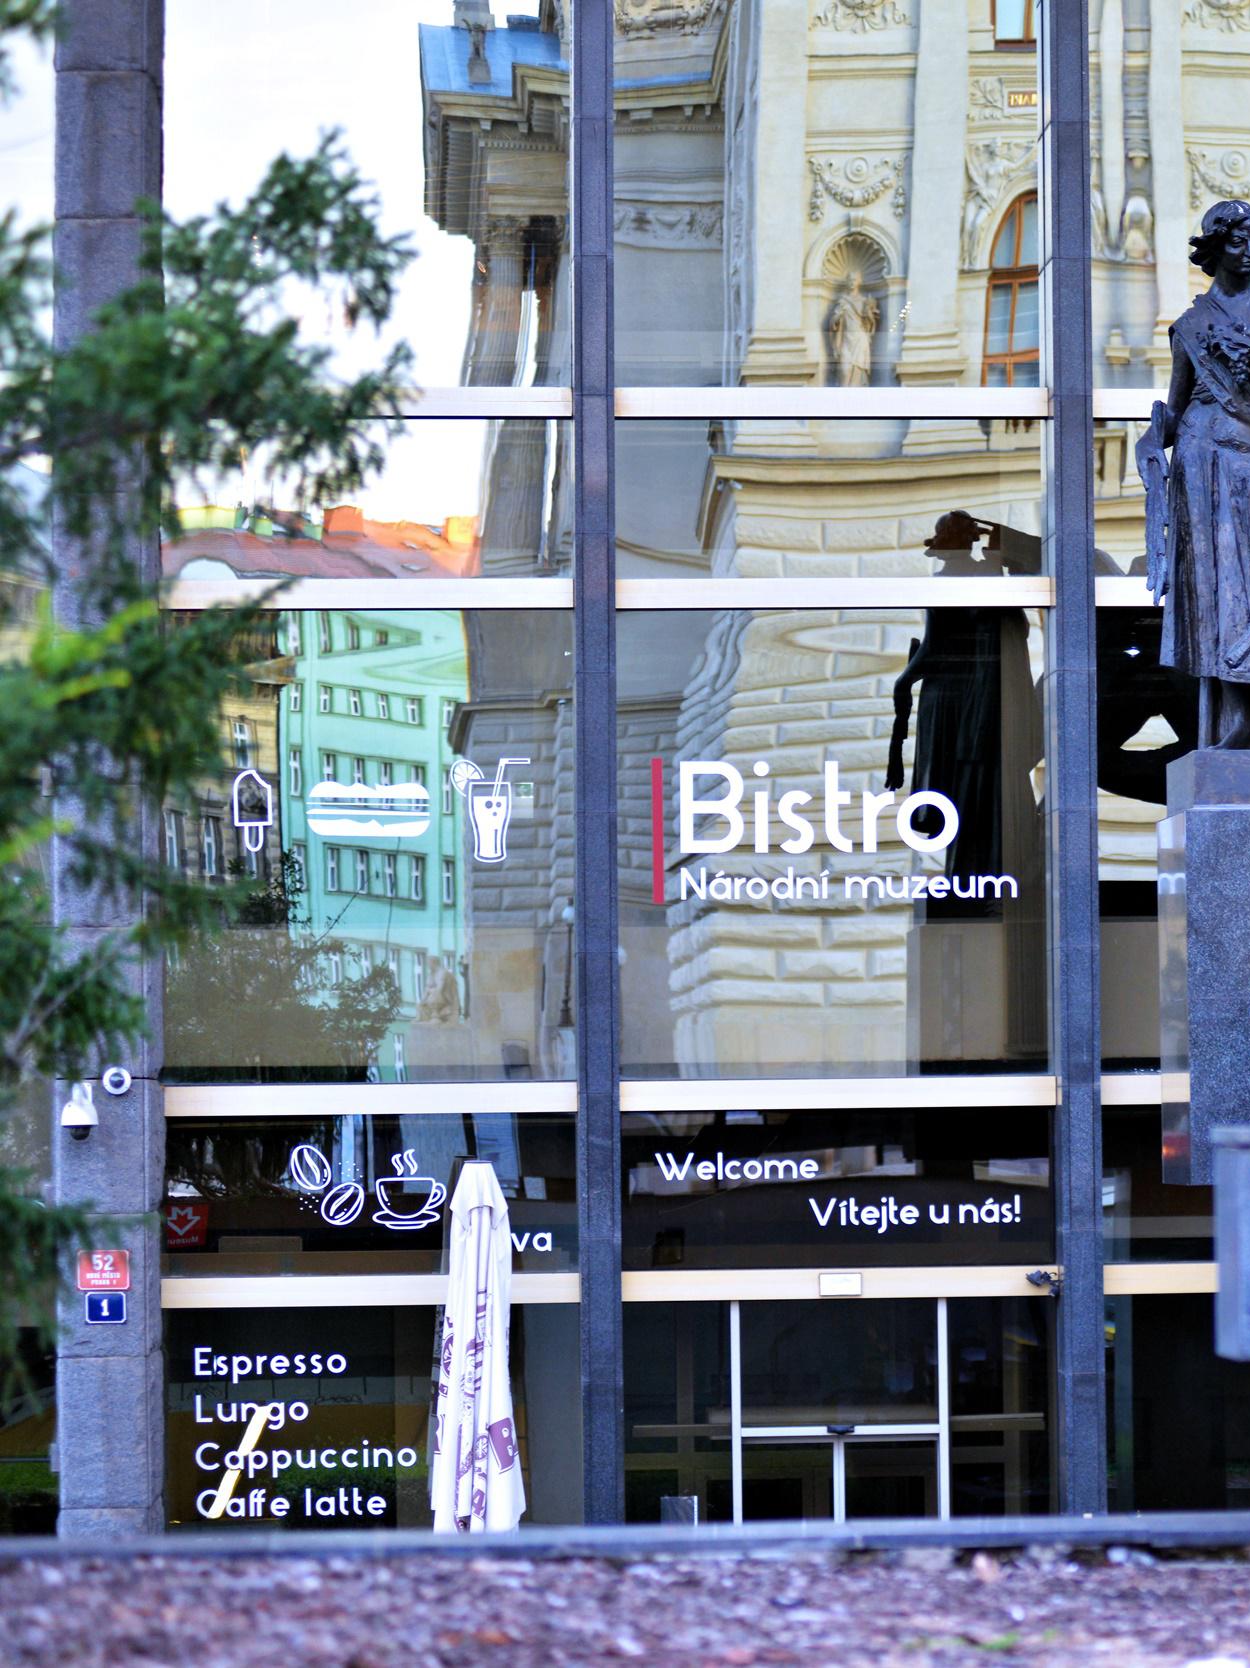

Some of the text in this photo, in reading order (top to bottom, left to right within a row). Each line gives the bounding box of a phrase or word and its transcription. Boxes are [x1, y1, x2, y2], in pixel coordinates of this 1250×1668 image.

[679, 759, 960, 855] Bistro
[679, 866, 1019, 901] Národní muzeum
[654, 1152, 819, 1181] Welcome
[808, 1194, 1021, 1234] Vítejte u nás!
[511, 1231, 553, 1252] va
[91, 1254, 115, 1271] 52
[100, 1298, 110, 1317] 1
[194, 1347, 347, 1384] Espresso
[196, 1395, 309, 1431] Lungo
[195, 1439, 417, 1479] Cappuccino
[196, 1487, 387, 1518] Caffe latte
